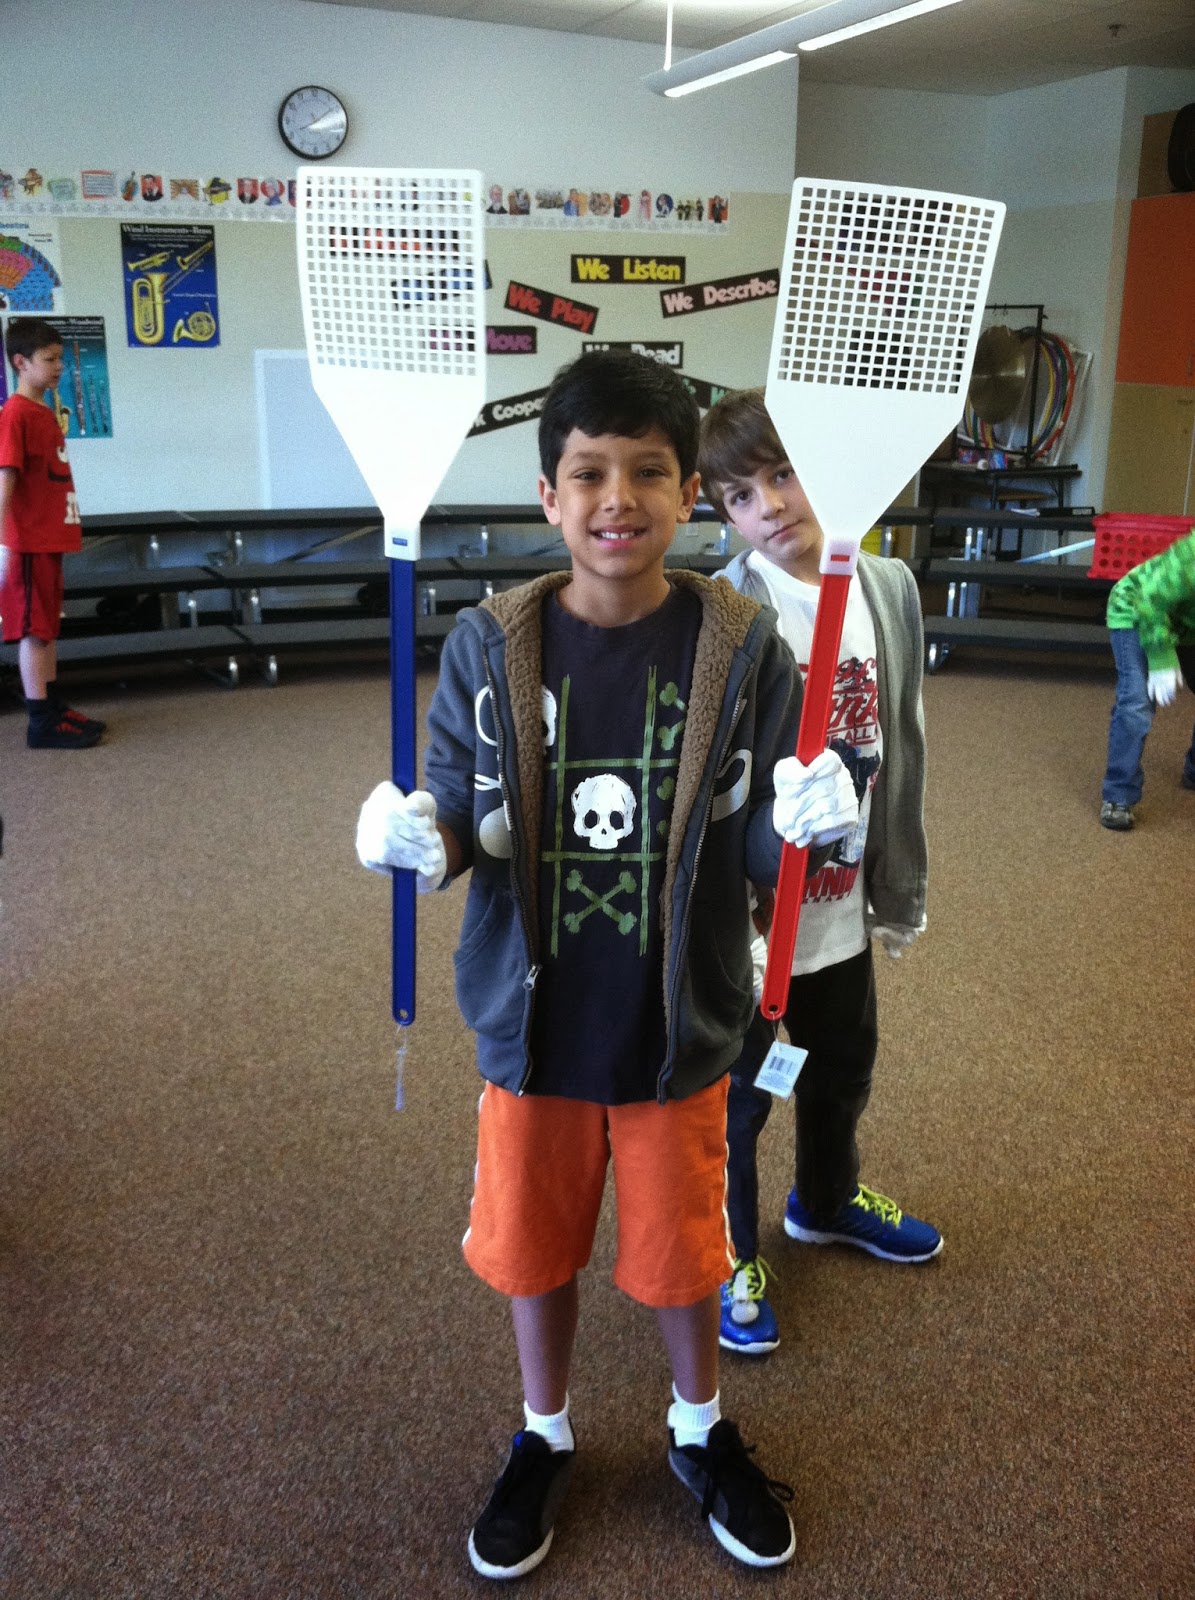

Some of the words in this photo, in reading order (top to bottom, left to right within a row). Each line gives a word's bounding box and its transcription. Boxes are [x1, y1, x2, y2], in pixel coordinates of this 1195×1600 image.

[577, 258, 609, 280] We
[623, 258, 681, 280] Listen
[509, 284, 541, 314] We
[551, 298, 594, 333] Play
[663, 292, 694, 314] We
[703, 276, 777, 305] Describe
